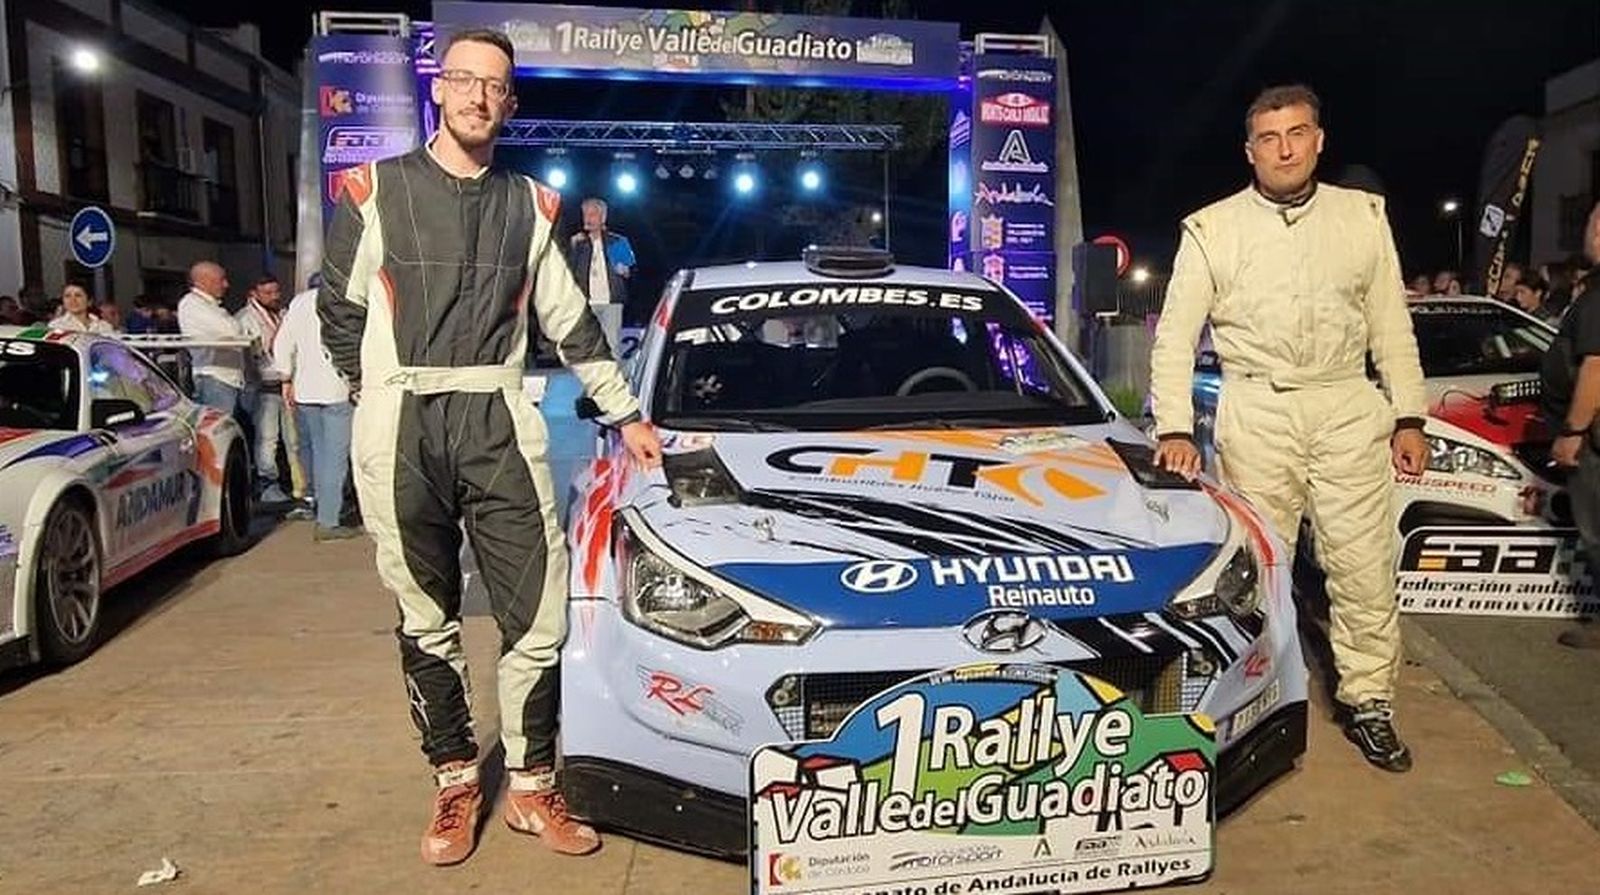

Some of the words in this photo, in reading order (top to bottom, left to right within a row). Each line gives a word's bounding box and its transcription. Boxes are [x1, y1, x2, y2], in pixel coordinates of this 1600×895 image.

[555, 21, 573, 54] 1
[573, 27, 643, 55] Rallye
[649, 27, 711, 54] Valle
[736, 31, 852, 60] Guadiato
[710, 286, 984, 315] COLOMBES.ES
[0, 341, 36, 356] S
[930, 554, 1135, 586] HYUNDAI
[987, 585, 1096, 607] Reinauto
[876, 692, 926, 797] 1
[930, 695, 1132, 773] Rallye
[771, 780, 912, 844] Valle
[909, 788, 966, 830] del
[966, 764, 1206, 825] Guadiato
[934, 881, 962, 894] de
[1086, 864, 1112, 880] de
[1117, 858, 1191, 877] Rallyes
